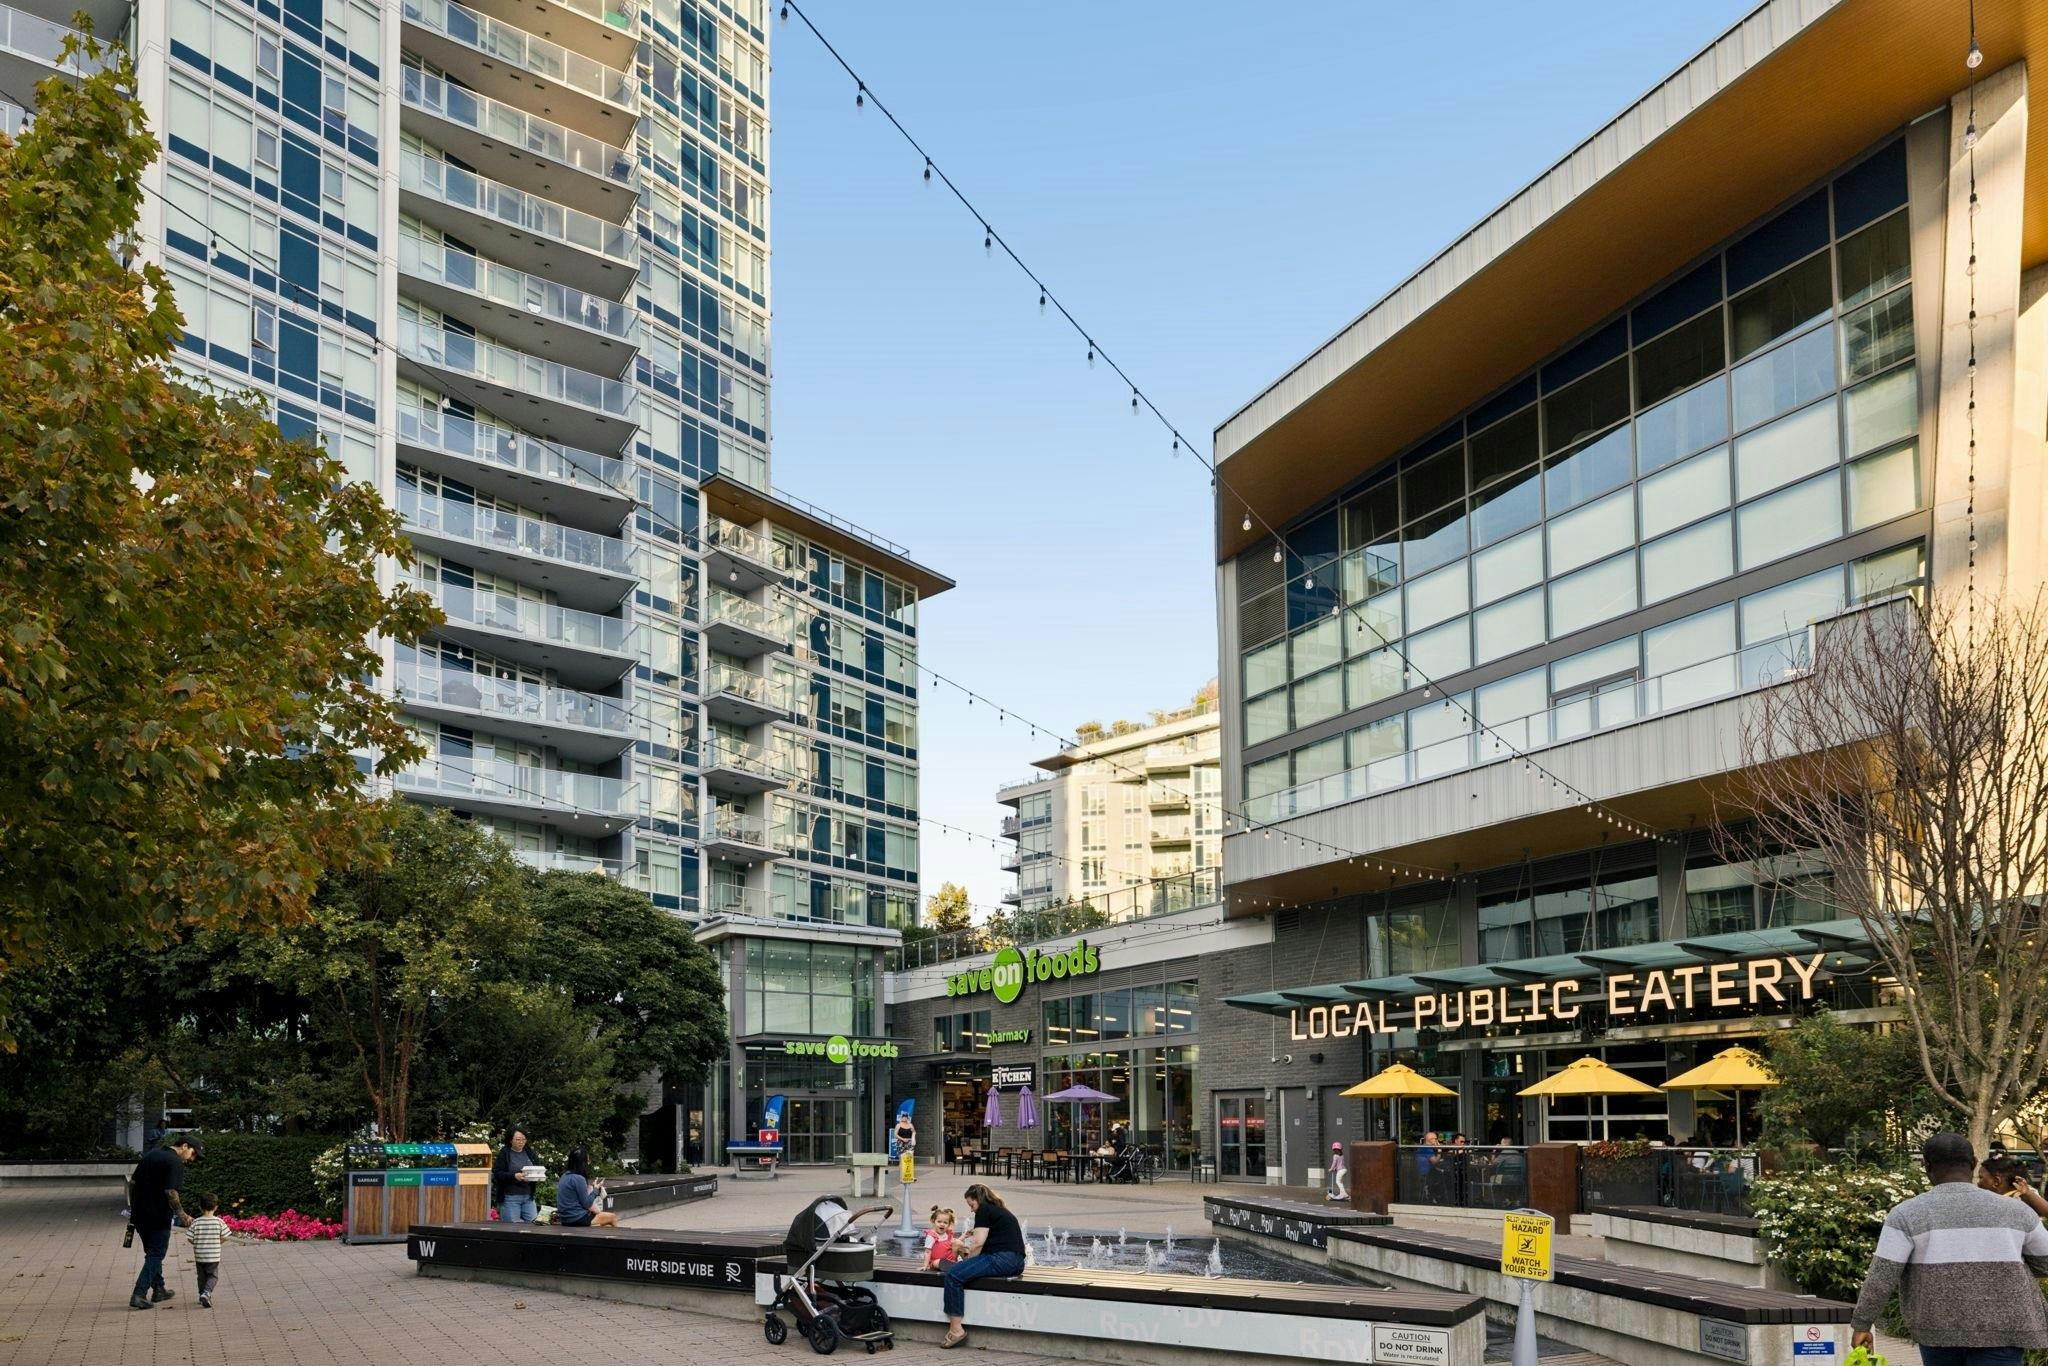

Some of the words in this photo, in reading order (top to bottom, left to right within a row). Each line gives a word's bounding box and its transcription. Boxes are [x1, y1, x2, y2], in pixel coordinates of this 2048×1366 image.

[946, 969, 992, 997] save
[993, 962, 1020, 987] on
[1027, 939, 1099, 982] foods
[1290, 1000, 1398, 1041] LOCAL
[1414, 979, 1580, 1031] PUBLIC
[1608, 953, 1826, 1016] EATERY
[987, 1029, 1029, 1046] pharmacy
[785, 1041, 826, 1055] save
[828, 1043, 849, 1055] on
[852, 1040, 898, 1057] foods
[992, 1070, 1031, 1086] KITCHEN
[1261, 1214, 1274, 1233] RDV
[1512, 1224, 1543, 1234] HAZARD
[627, 1258, 659, 1272] RIVER
[660, 1260, 686, 1275] SIDE
[688, 1263, 714, 1277] VIBE
[1512, 1257, 1541, 1267] WATCH
[1504, 1264, 1525, 1274] YOUR
[1528, 1268, 1548, 1277] STEP
[1392, 1332, 1430, 1341] CAUTION
[1379, 1342, 1393, 1350] DO
[1395, 1344, 1413, 1352] NOT
[1416, 1346, 1443, 1354] DRINK
[1406, 1353, 1440, 1361] recirculated
